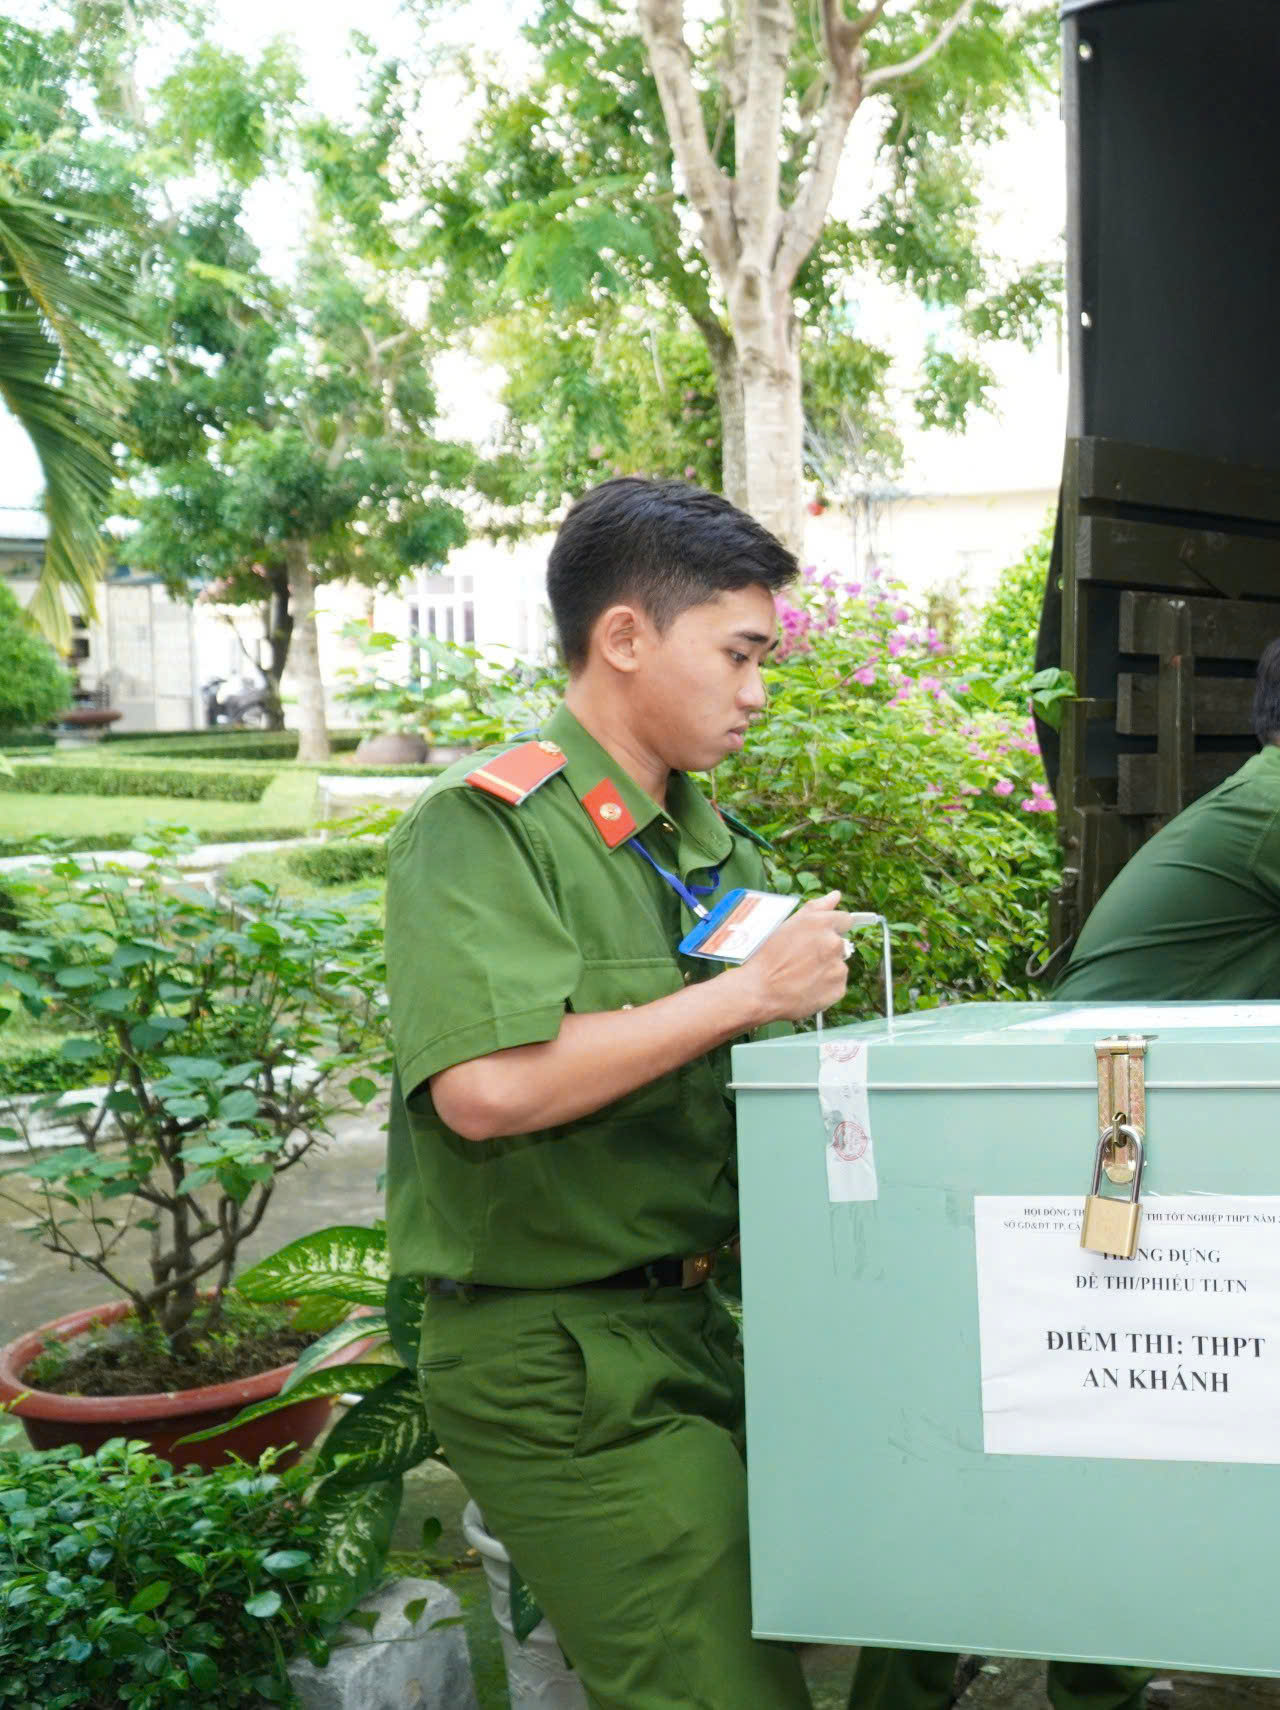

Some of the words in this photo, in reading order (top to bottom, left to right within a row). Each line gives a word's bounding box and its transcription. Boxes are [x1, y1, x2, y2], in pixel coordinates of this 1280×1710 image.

[1053, 1221, 1067, 1232] TP.
[1146, 1213, 1163, 1222] THI
[1227, 1214, 1251, 1224] THPT
[1169, 1247, 1221, 1266] ĐỰNG
[1075, 1271, 1099, 1289] ĐỀ
[1199, 1278, 1248, 1293] TLTN
[1045, 1325, 1118, 1352] ĐIỂM
[1125, 1333, 1184, 1355] THI:
[1191, 1335, 1266, 1358] THPT
[1083, 1367, 1120, 1388] AN
[1128, 1364, 1230, 1393] KHÁNH
